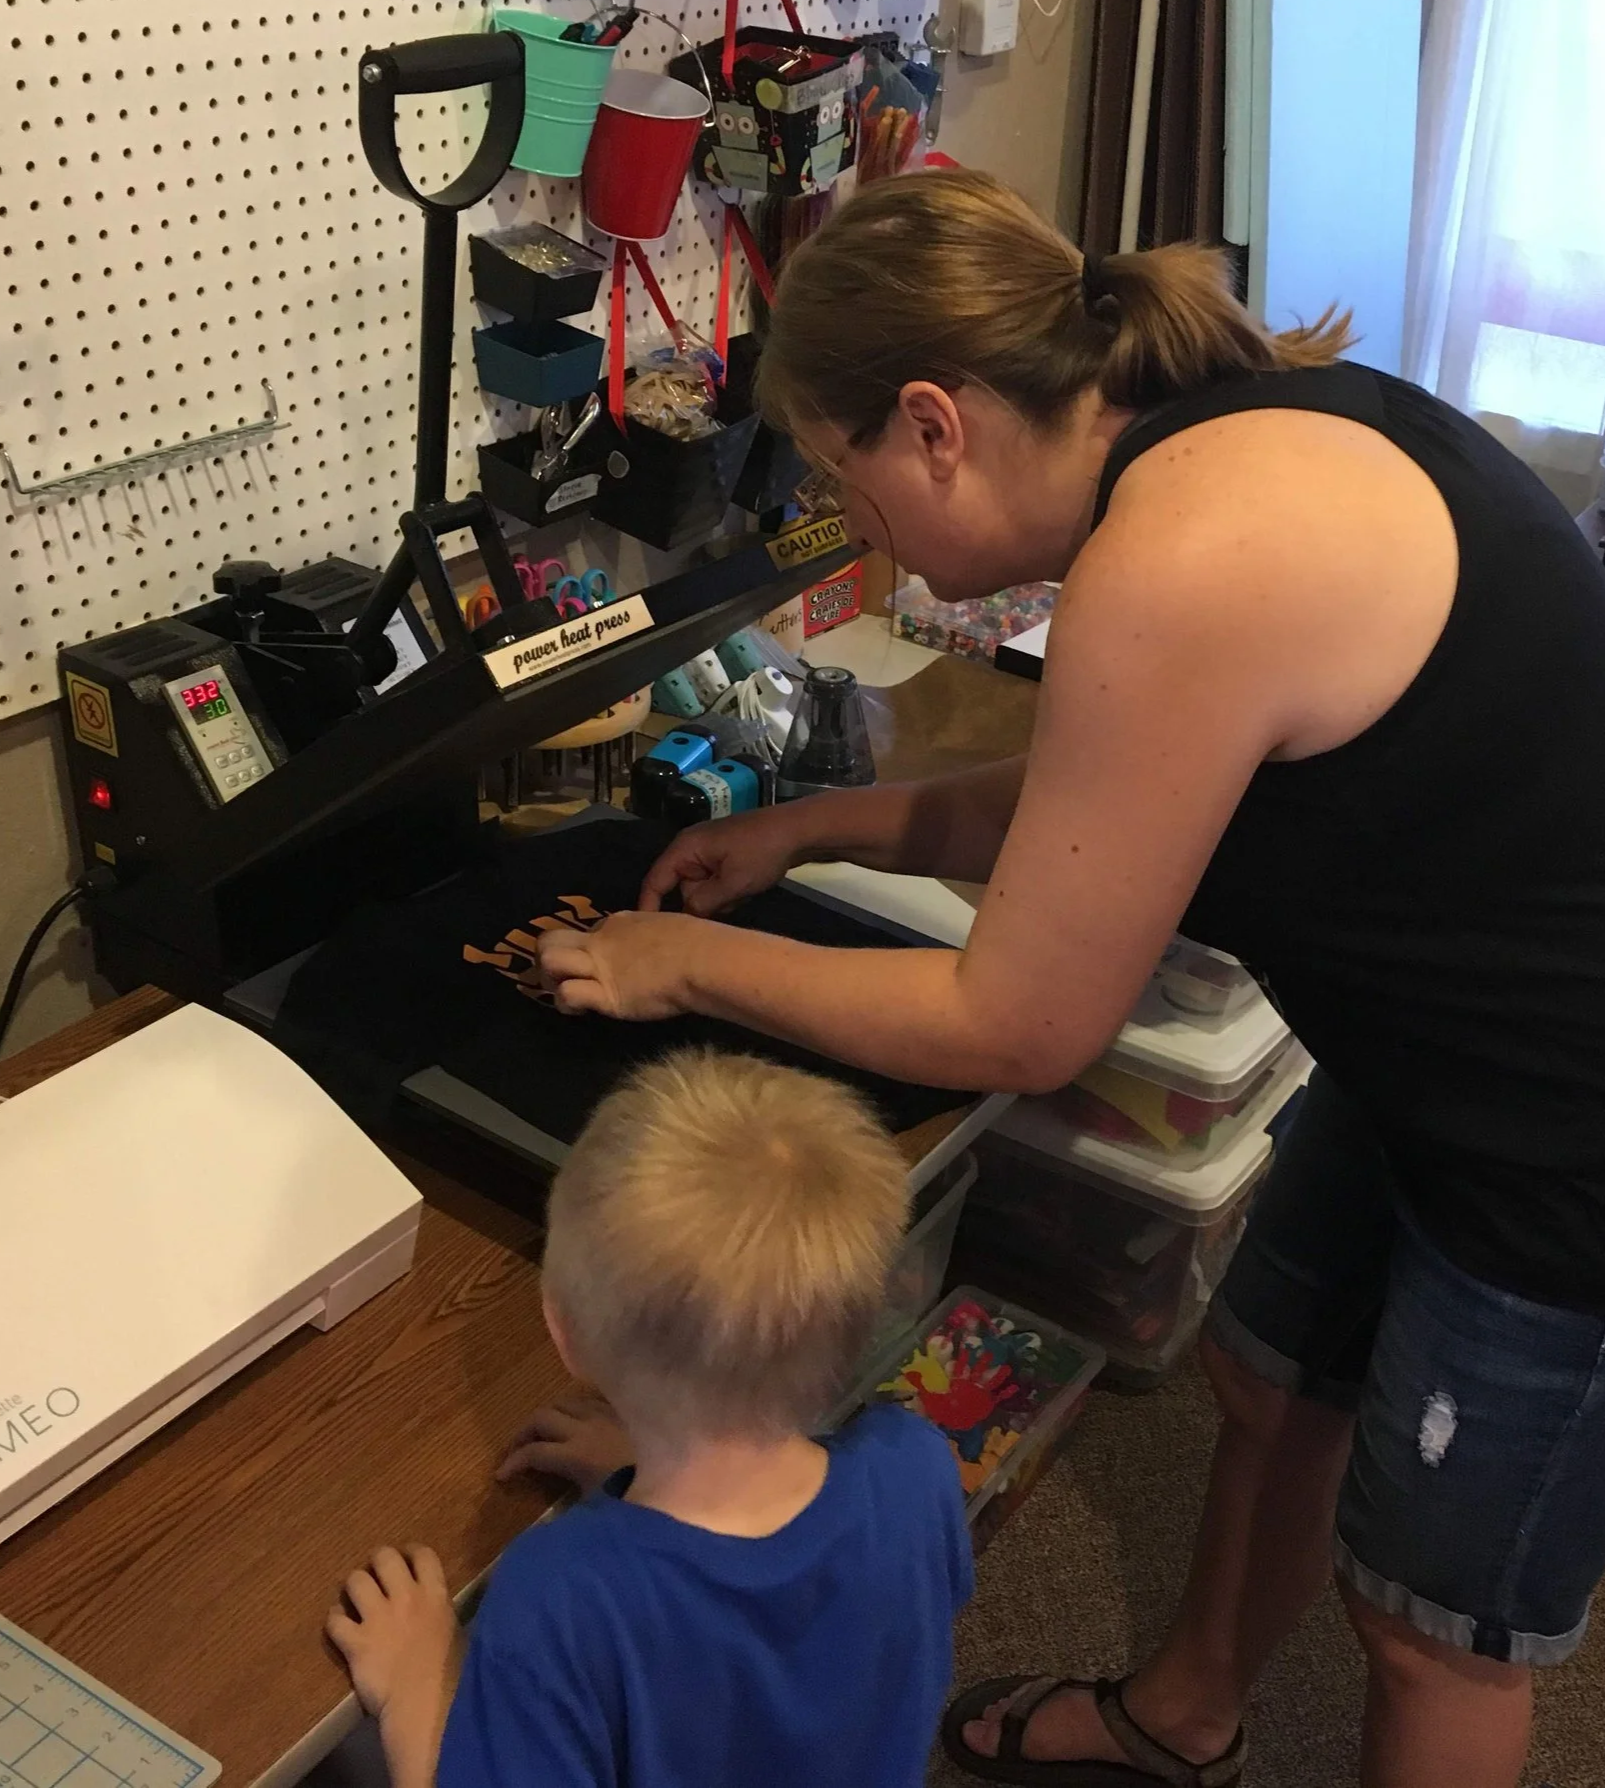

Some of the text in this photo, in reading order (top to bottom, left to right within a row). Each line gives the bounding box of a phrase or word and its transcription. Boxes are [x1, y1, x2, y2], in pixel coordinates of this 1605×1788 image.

[810, 579, 856, 606] CRAYONS
[808, 596, 855, 622] CRAIES DE
[823, 609, 841, 624] CIRE
[513, 610, 631, 674] power heat press
[182, 680, 219, 708] 332
[203, 698, 228, 719] 30
[102, 1731, 116, 1744] 2
